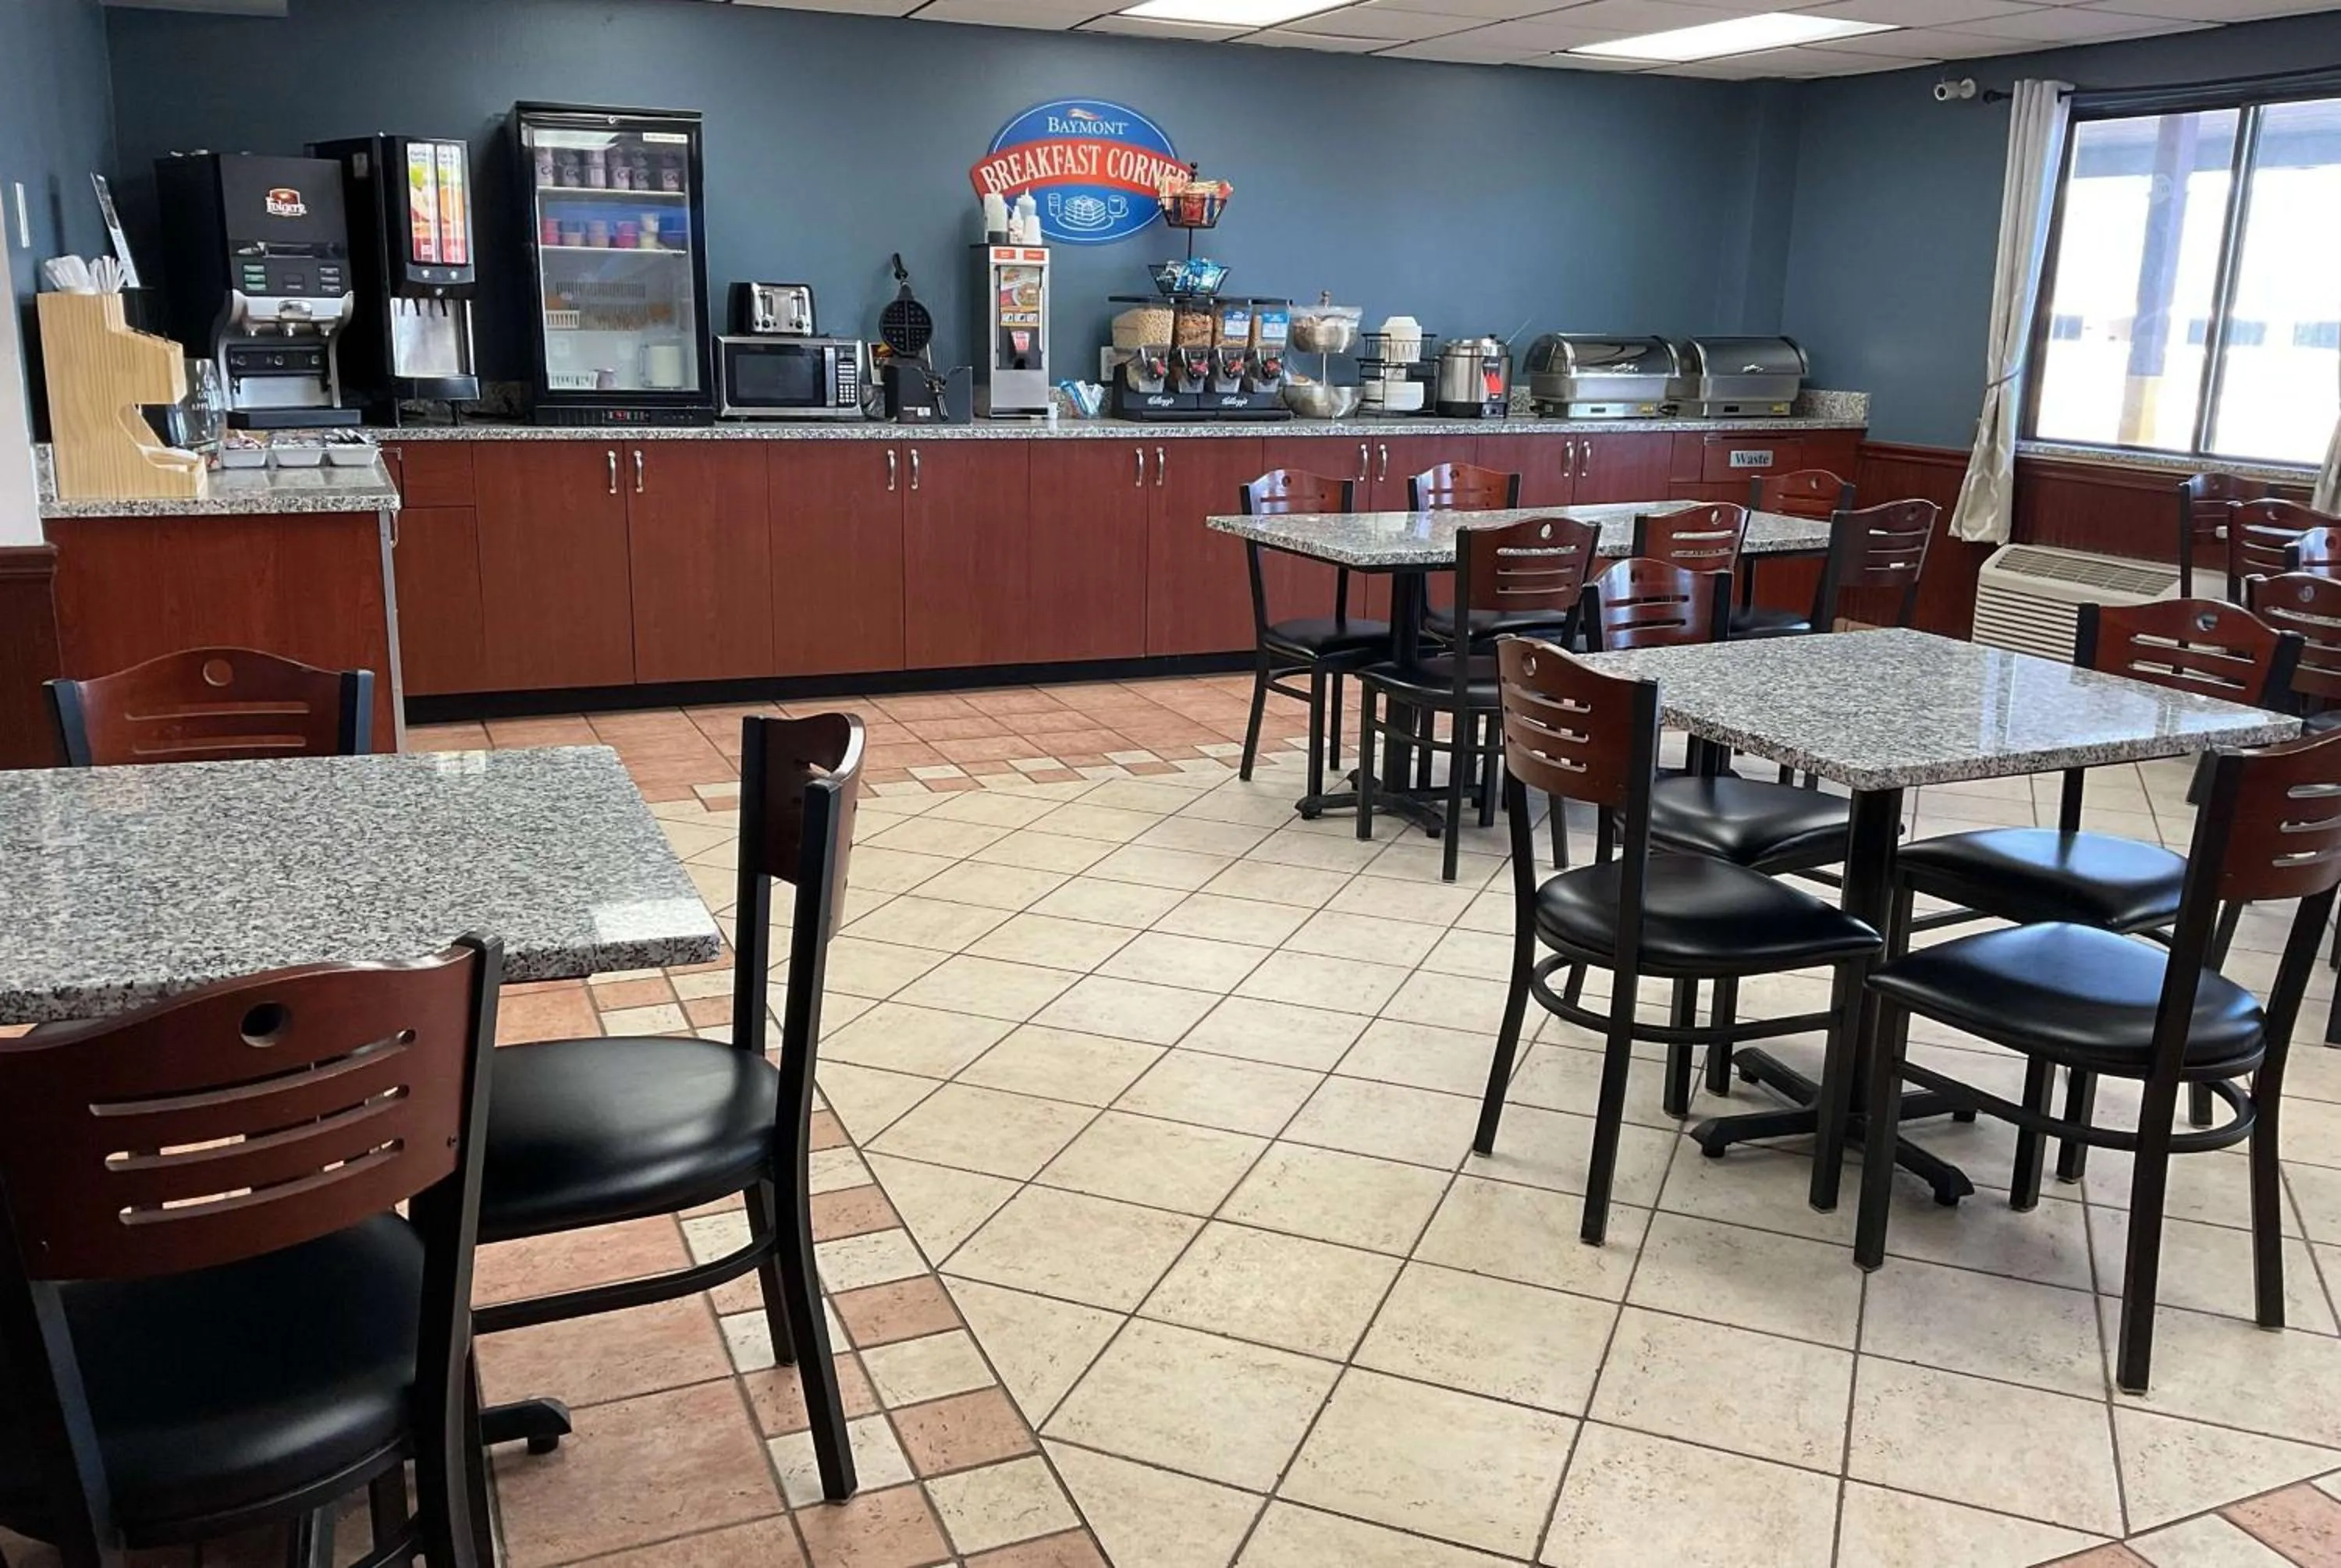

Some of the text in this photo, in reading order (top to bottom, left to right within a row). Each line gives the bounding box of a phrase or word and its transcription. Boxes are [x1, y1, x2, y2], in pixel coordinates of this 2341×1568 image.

[1048, 116, 1128, 135] BAYMONT
[980, 144, 1102, 194] BREAKFAST
[1735, 452, 1769, 465] Waste
